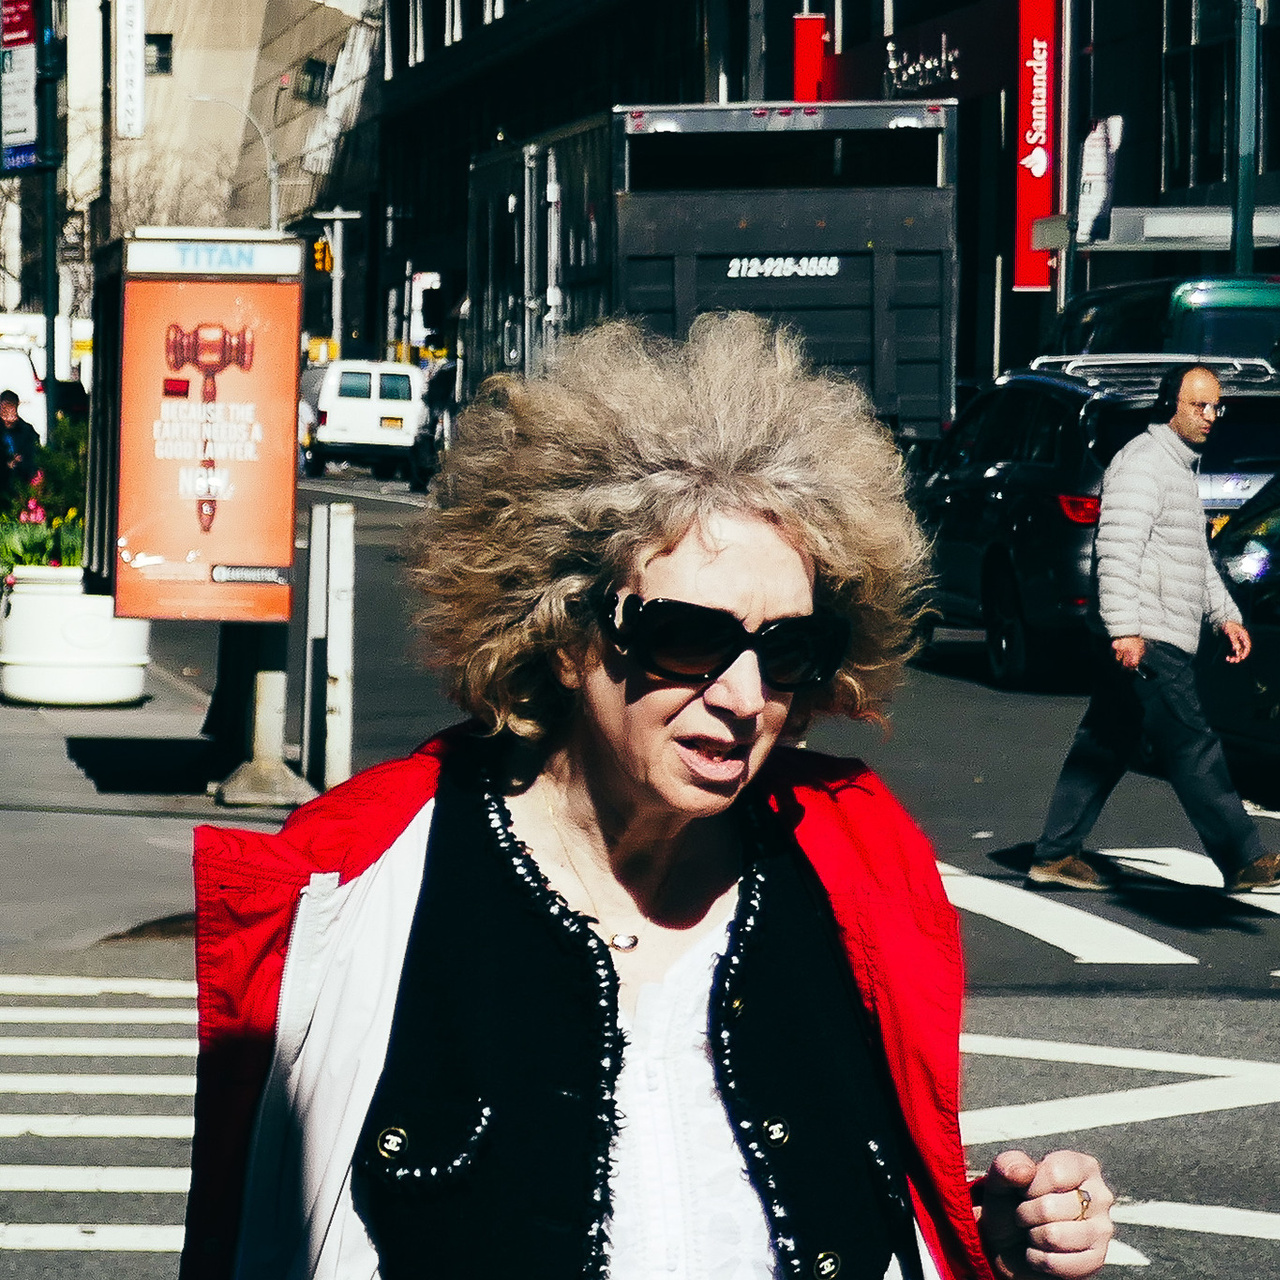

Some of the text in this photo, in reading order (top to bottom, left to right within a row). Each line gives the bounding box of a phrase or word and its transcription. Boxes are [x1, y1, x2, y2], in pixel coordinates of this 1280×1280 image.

[1025, 37, 1048, 145] Santander
[175, 244, 254, 267] TITAN
[161, 401, 255, 423] BECAUSE THE
[153, 421, 262, 442] EARTH NEEDS A
[155, 440, 194, 459] GOOD
